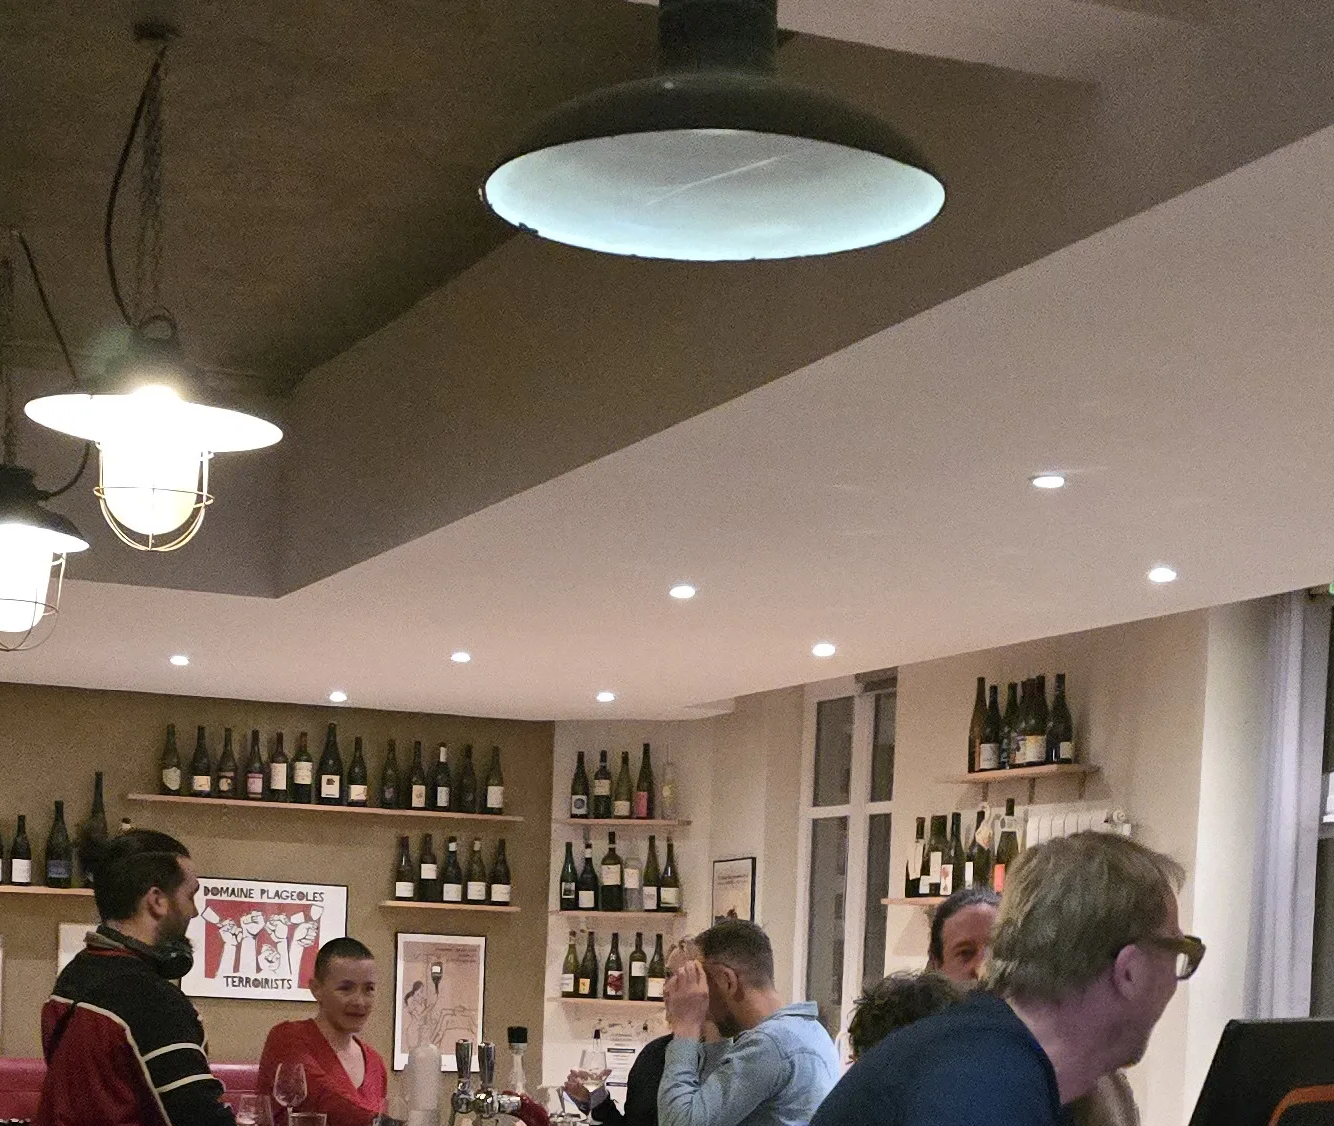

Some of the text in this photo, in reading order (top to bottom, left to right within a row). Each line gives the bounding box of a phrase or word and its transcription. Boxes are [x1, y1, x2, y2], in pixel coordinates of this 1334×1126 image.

[203, 885, 325, 902] DOMAINE PLAGEOLES
[223, 975, 293, 990] TERROIRISTS
